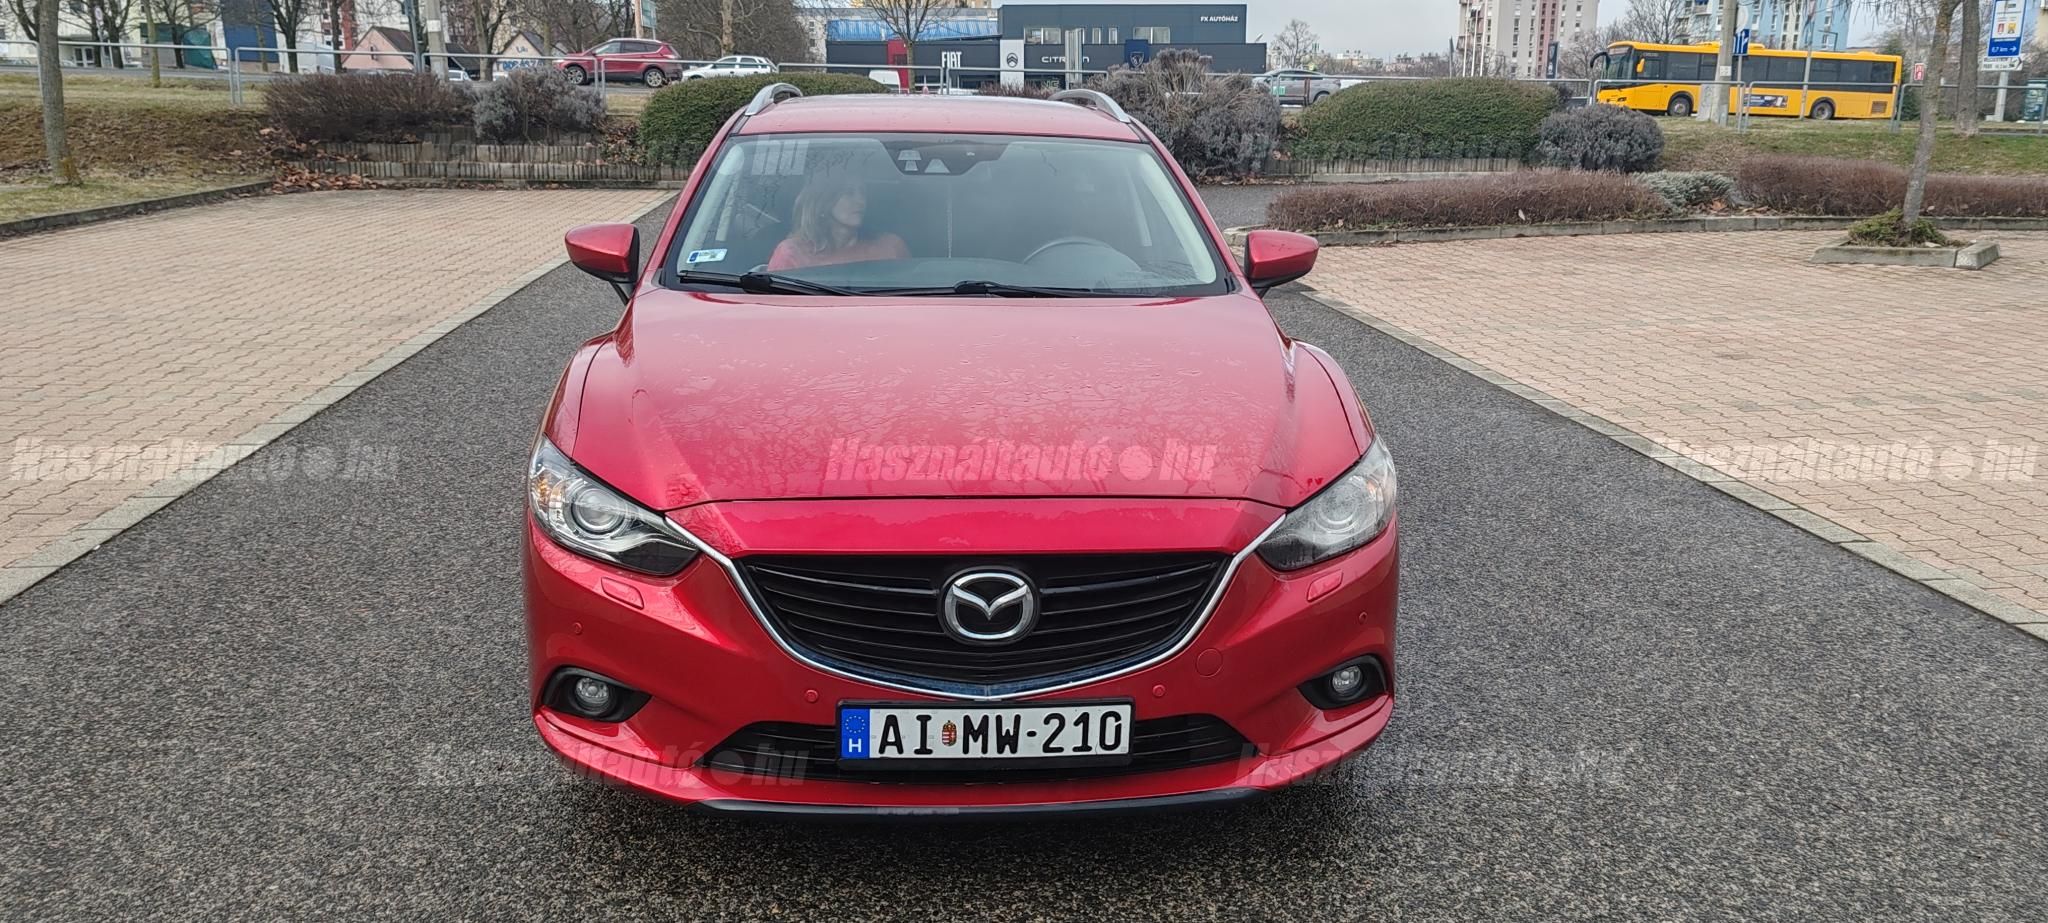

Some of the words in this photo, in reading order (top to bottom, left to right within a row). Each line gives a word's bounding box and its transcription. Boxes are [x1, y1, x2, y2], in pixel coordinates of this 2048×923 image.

[1210, 14, 1239, 22] AUTÓHÁZ
[941, 51, 962, 68] FIAT
[1041, 55, 1090, 63] CITRN
[878, 713, 934, 755] AI
[962, 710, 1123, 755] MW-210
[848, 738, 862, 753] H
